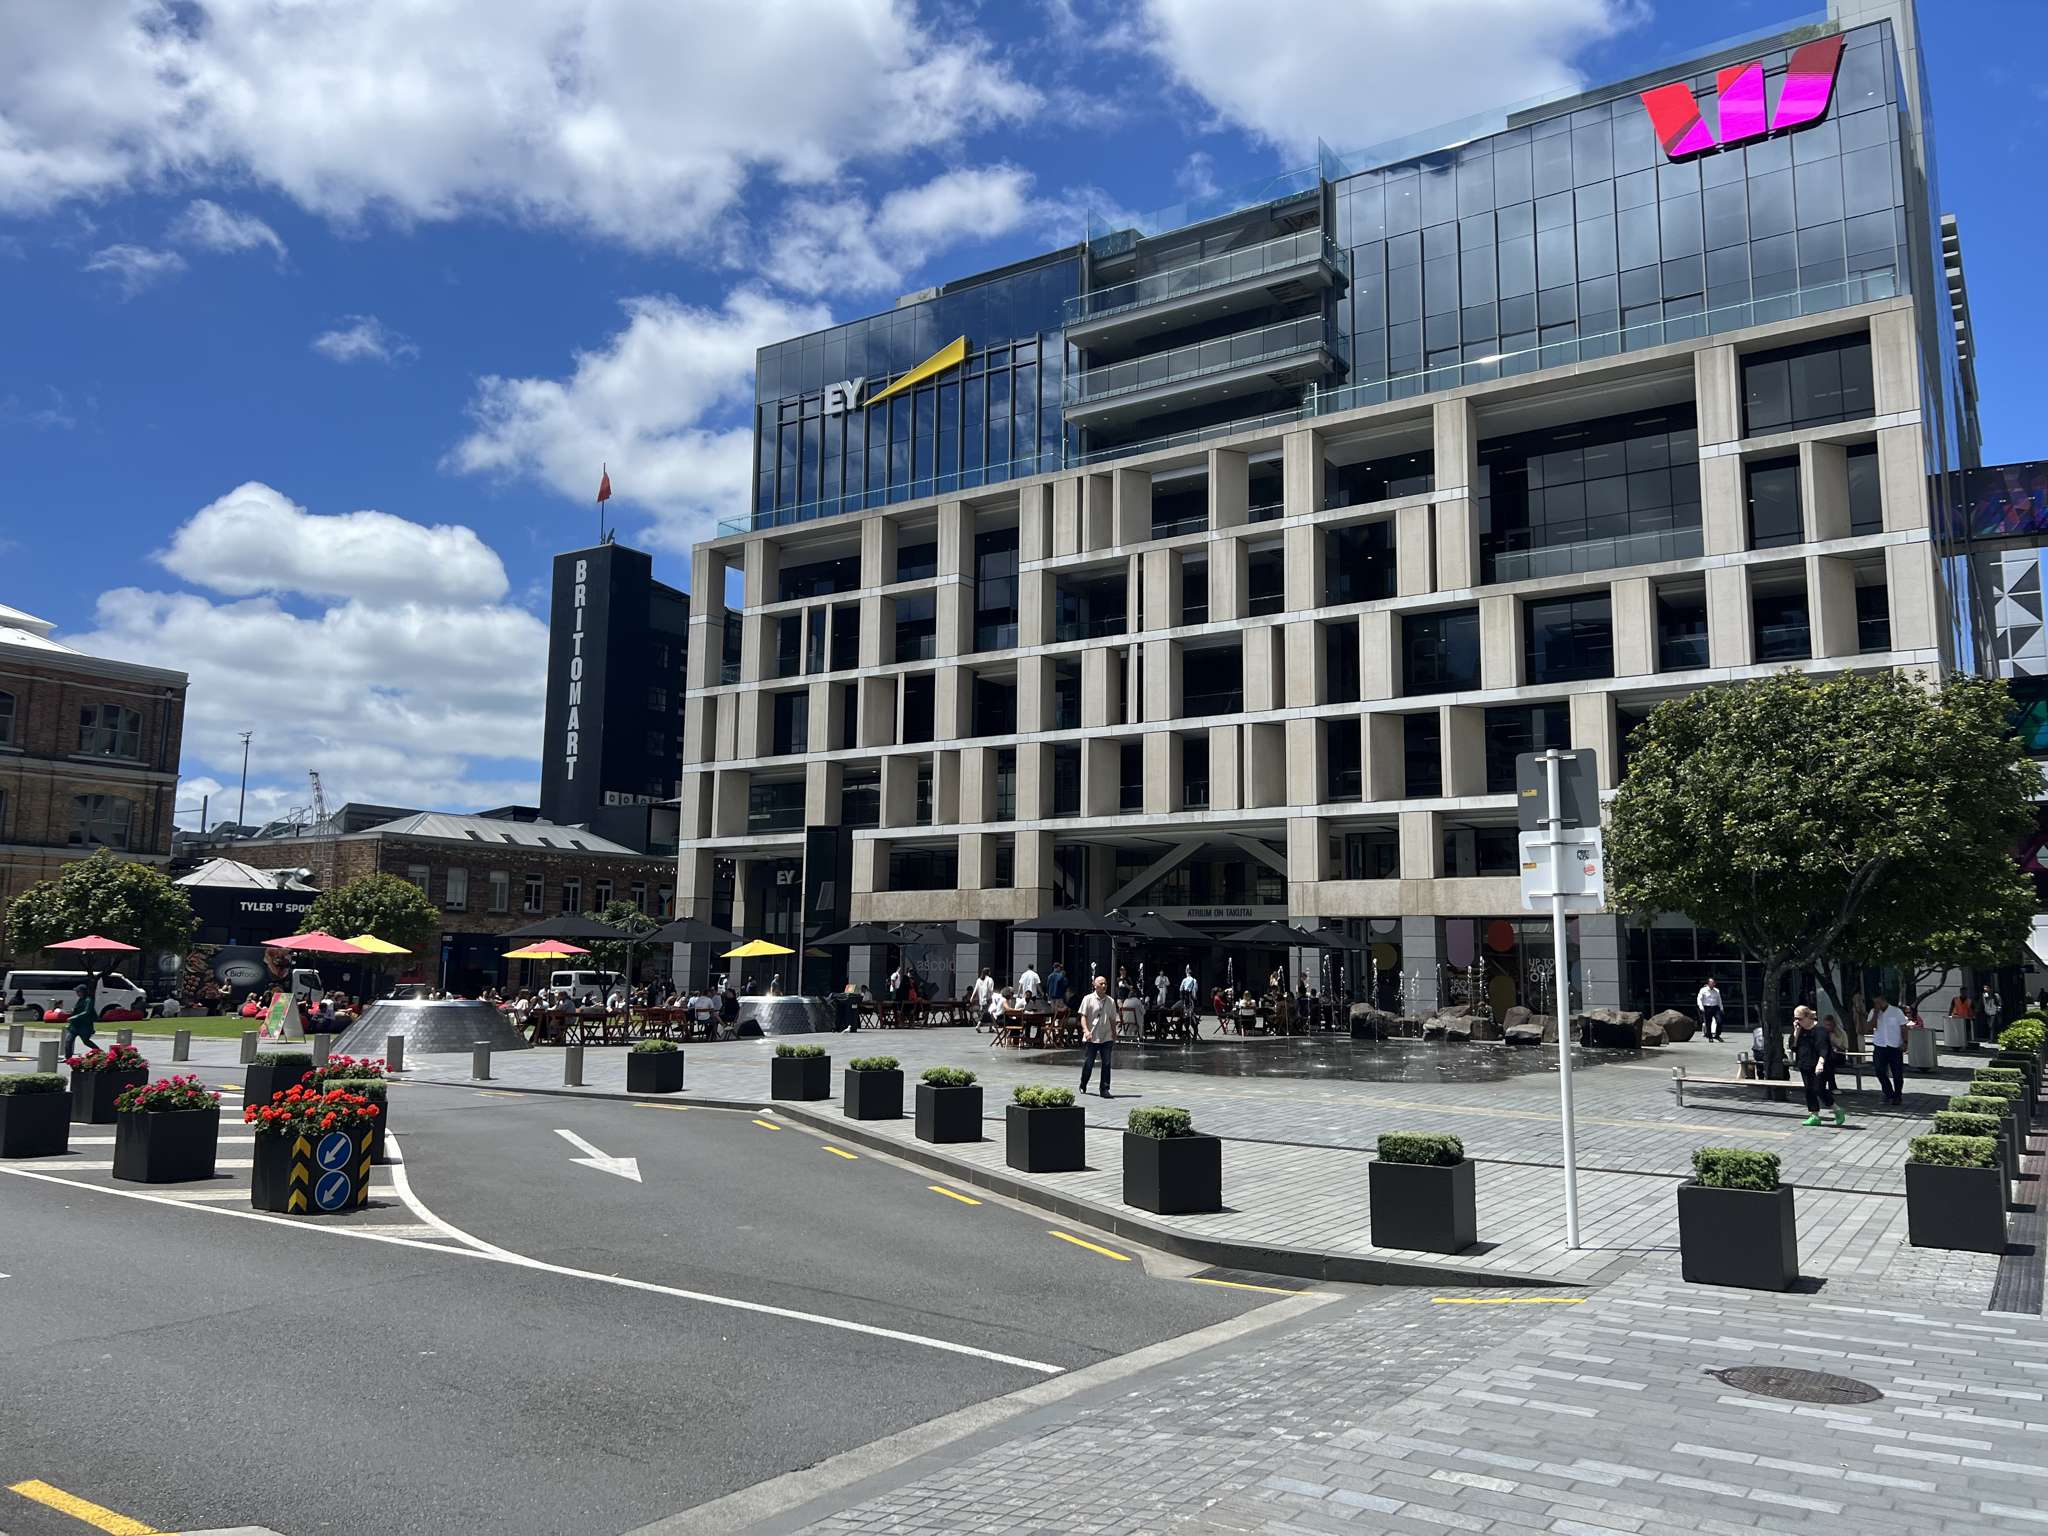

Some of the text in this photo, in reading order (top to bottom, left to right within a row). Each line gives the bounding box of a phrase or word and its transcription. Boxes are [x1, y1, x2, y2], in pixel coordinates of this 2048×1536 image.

[824, 376, 866, 416] EY
[565, 559, 588, 781] BRITOMART
[776, 870, 796, 885] EY
[240, 901, 273, 912] TYLER
[1187, 908, 1252, 917] ATRIUM ON TAKUTAI
[1528, 958, 1555, 966] UP TO
